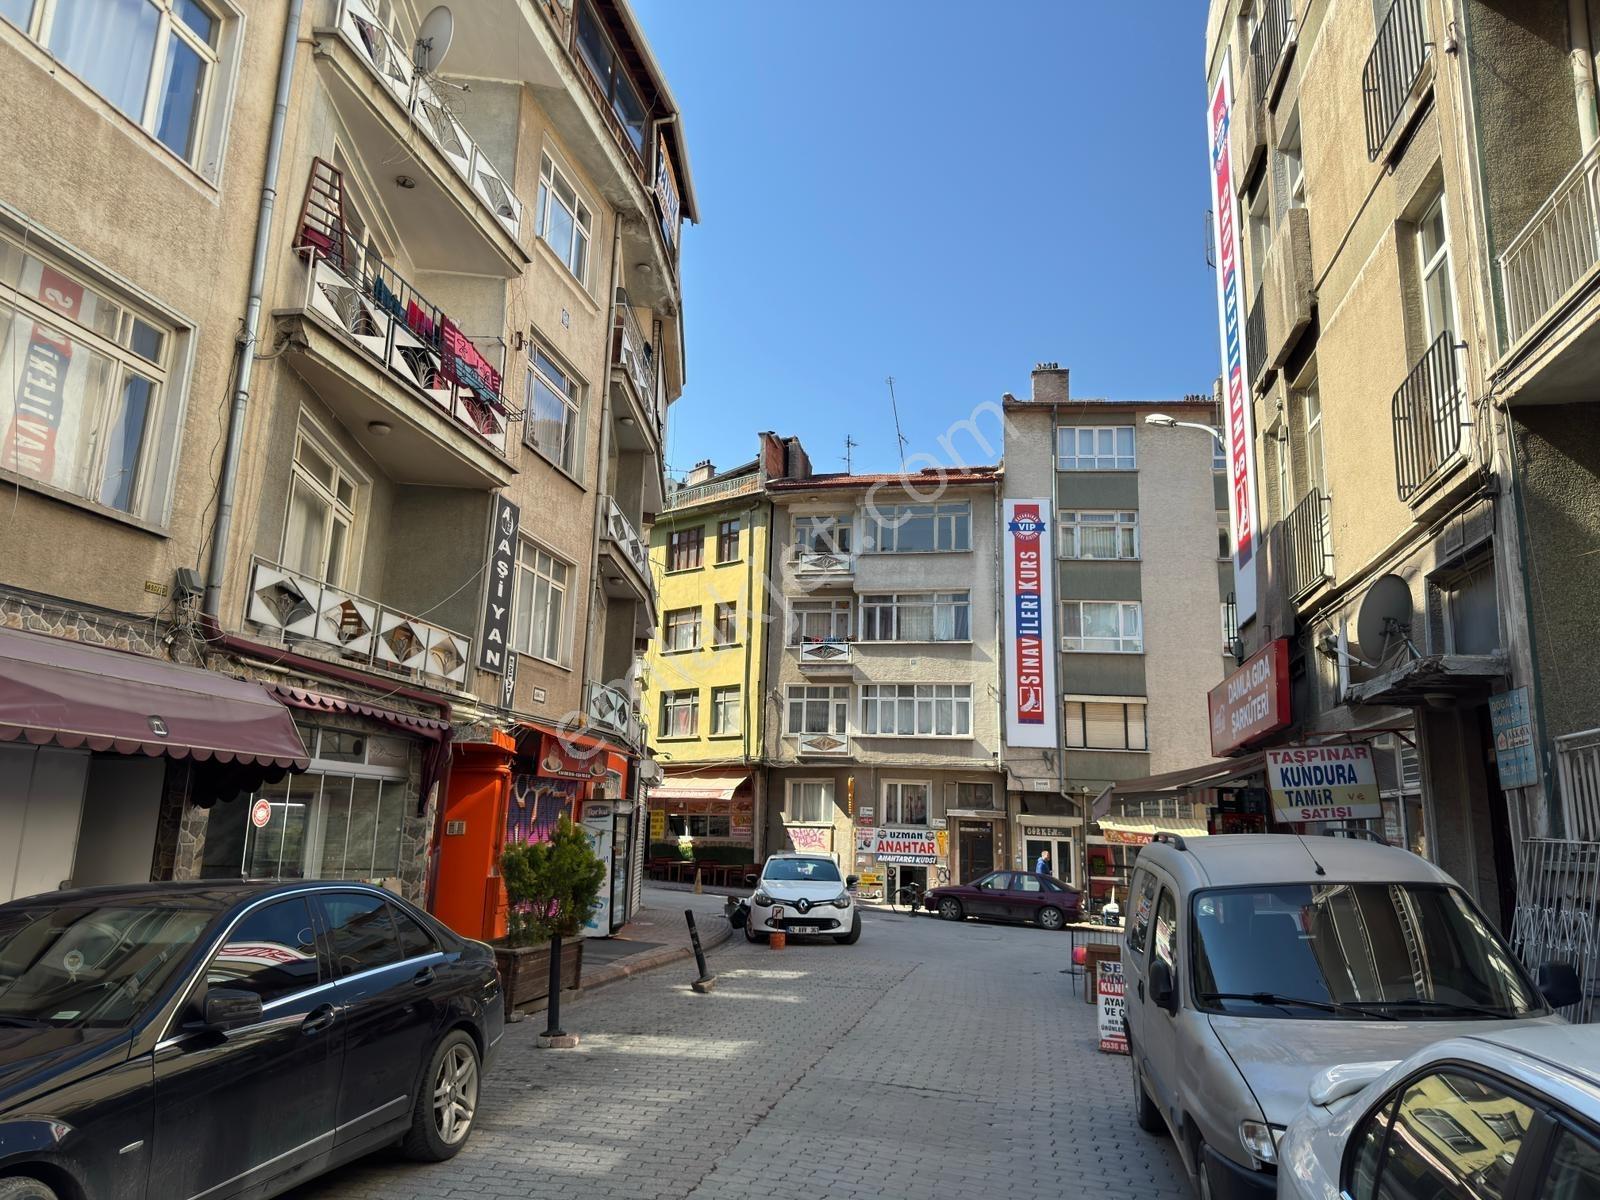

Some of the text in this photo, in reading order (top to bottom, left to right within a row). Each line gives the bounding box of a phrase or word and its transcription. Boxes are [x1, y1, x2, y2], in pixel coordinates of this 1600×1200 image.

[1018, 523, 1036, 531] VIP
[1018, 551, 1038, 590] KURS
[1019, 594, 1038, 635] İLERİ
[1020, 638, 1040, 685] SINAV
[1228, 655, 1271, 705] DAMLA GIDA
[1231, 686, 1269, 740] ŞARKÜTERİ
[1269, 747, 1369, 767] TAŞPINAR
[1280, 763, 1358, 788] KUNDURA
[889, 831, 923, 840] UZMAN
[1137, 835, 1153, 844] FAT
[877, 840, 936, 854] ANAHTAR
[877, 855, 915, 863] ANAHTARCI
[1103, 963, 1122, 973] SE
[1100, 981, 1125, 994] KUN
[1104, 997, 1125, 1007] AYA
[1104, 1007, 1116, 1017] VE
